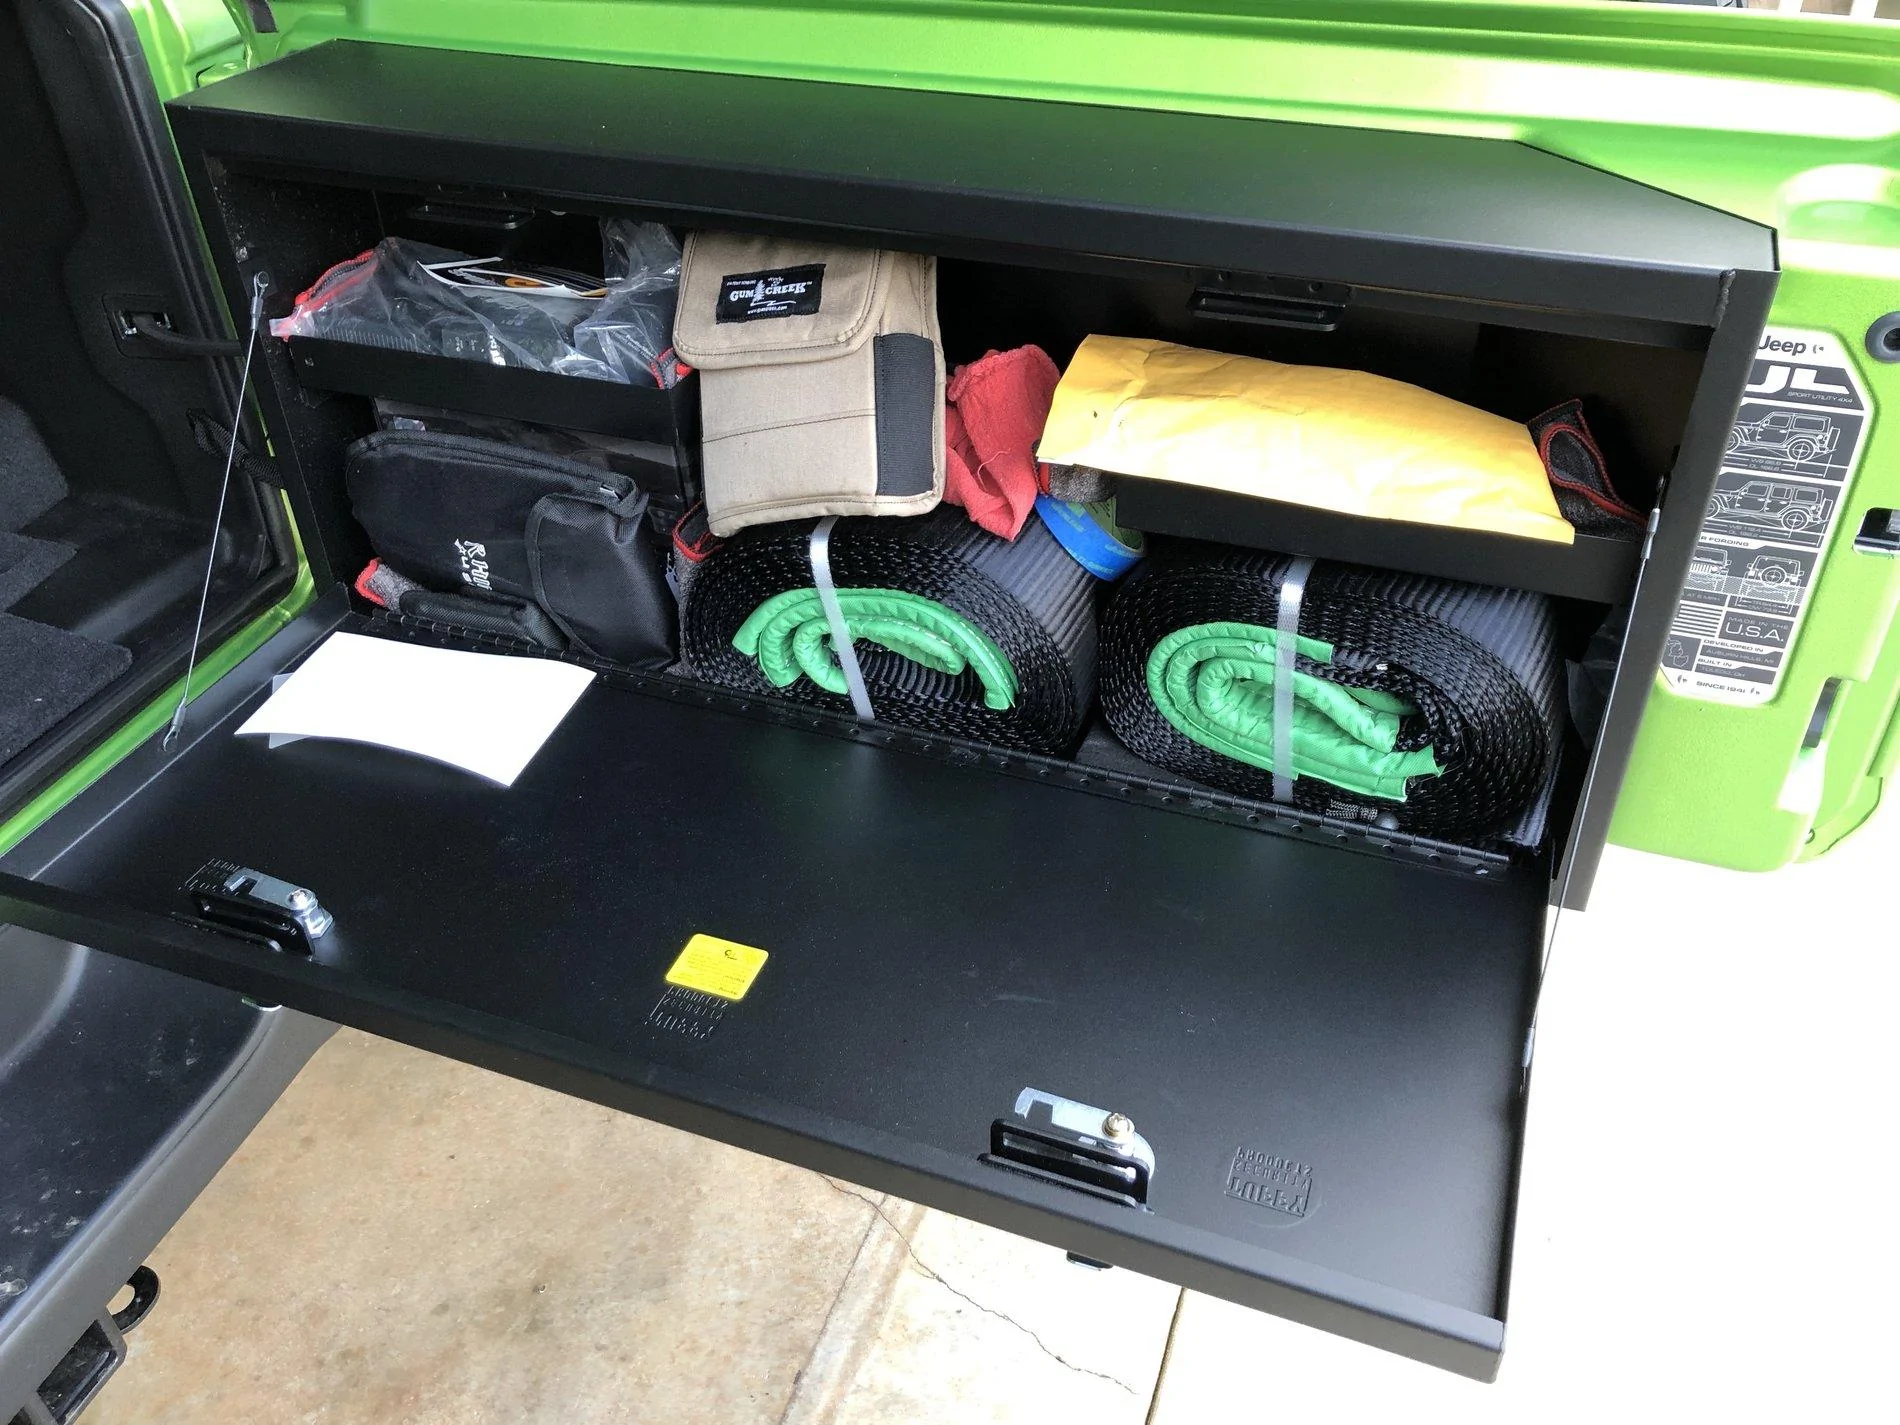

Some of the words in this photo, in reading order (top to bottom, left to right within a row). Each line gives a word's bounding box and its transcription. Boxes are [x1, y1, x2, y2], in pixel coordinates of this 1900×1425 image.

[729, 289, 755, 302] GUM
[765, 282, 807, 295] CREEK
[1758, 335, 1807, 356] Jeep
[1709, 537, 1749, 547] FORDING
[1728, 616, 1756, 624] MADE
[1772, 622, 1789, 630] THE
[1725, 621, 1784, 642] U.S.A.
[1703, 639, 1754, 651] DEVELOPED
[1705, 649, 1739, 658] AUBURN
[1696, 680, 1726, 691] SINCE
[1727, 686, 1746, 694] 1941
